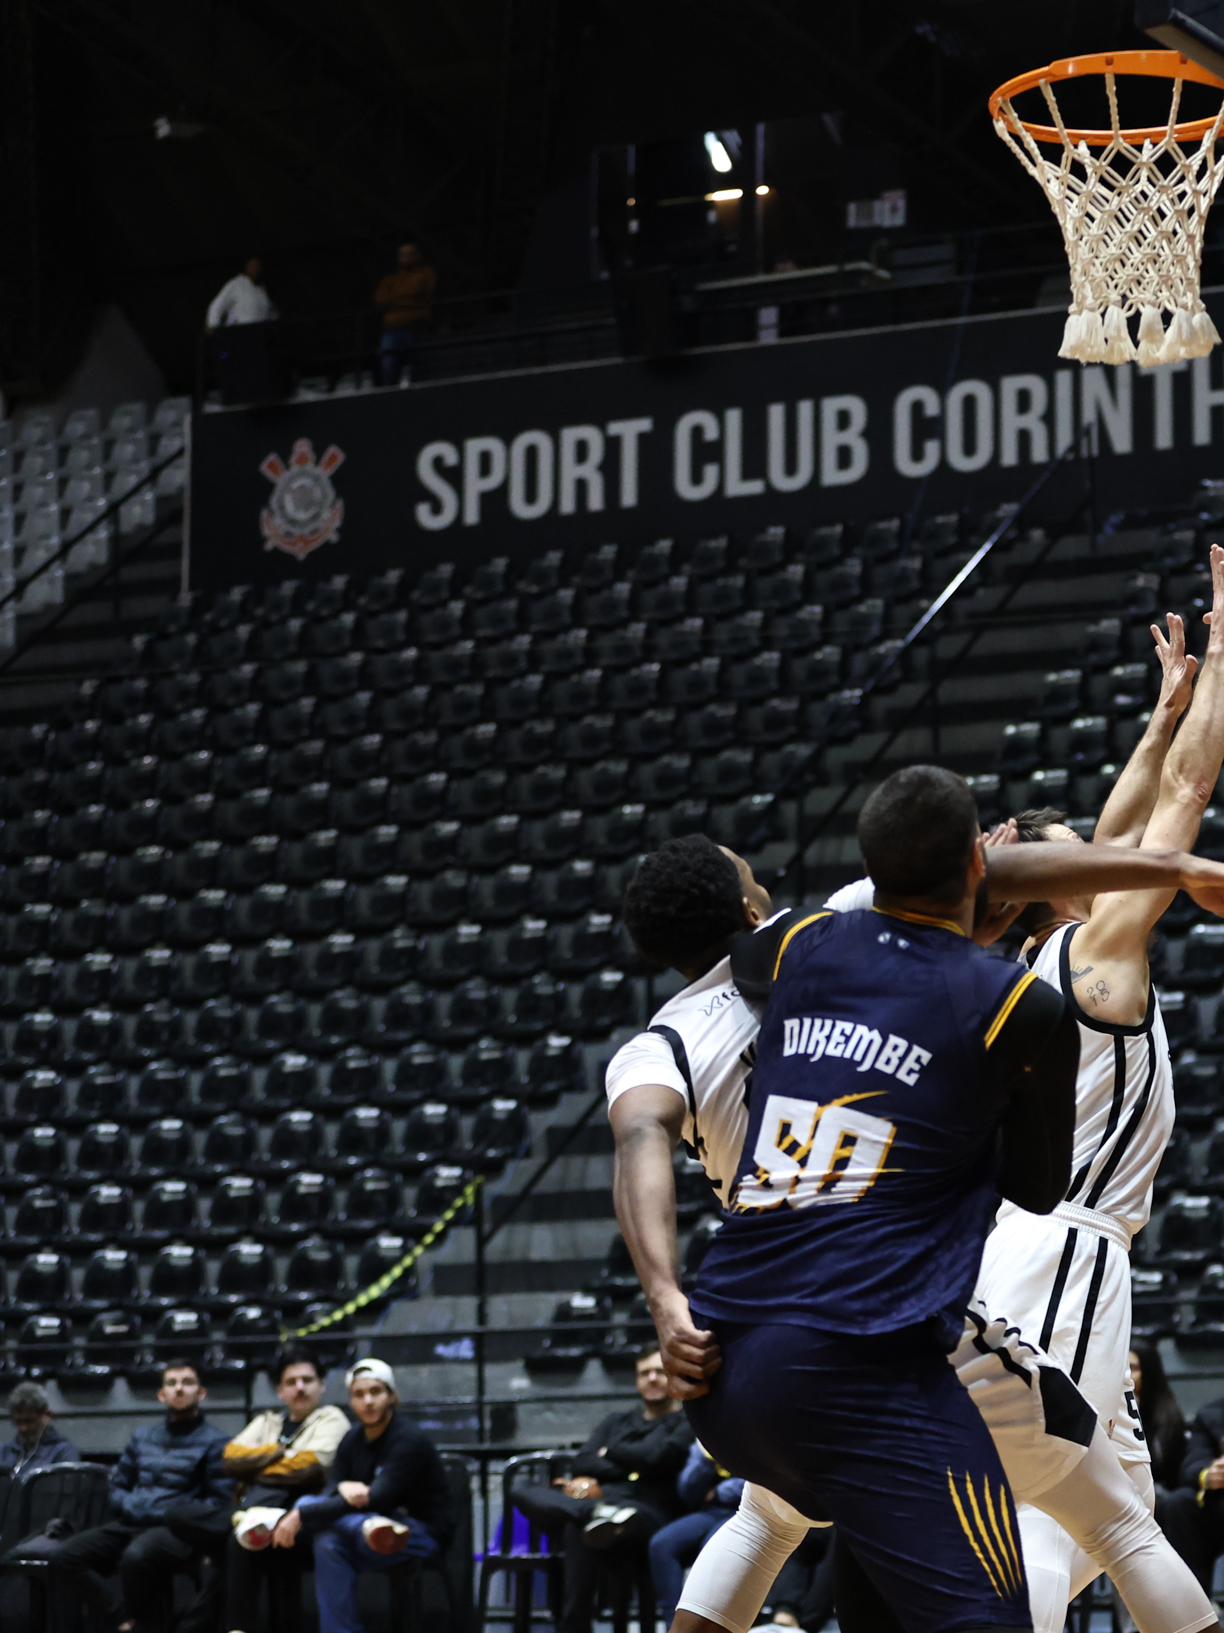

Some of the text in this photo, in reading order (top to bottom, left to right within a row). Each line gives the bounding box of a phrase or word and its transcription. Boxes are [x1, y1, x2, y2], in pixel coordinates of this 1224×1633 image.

[415, 417, 653, 530] SPORT
[673, 394, 869, 501] CLUB
[783, 1017, 933, 1086] DIKEMBE
